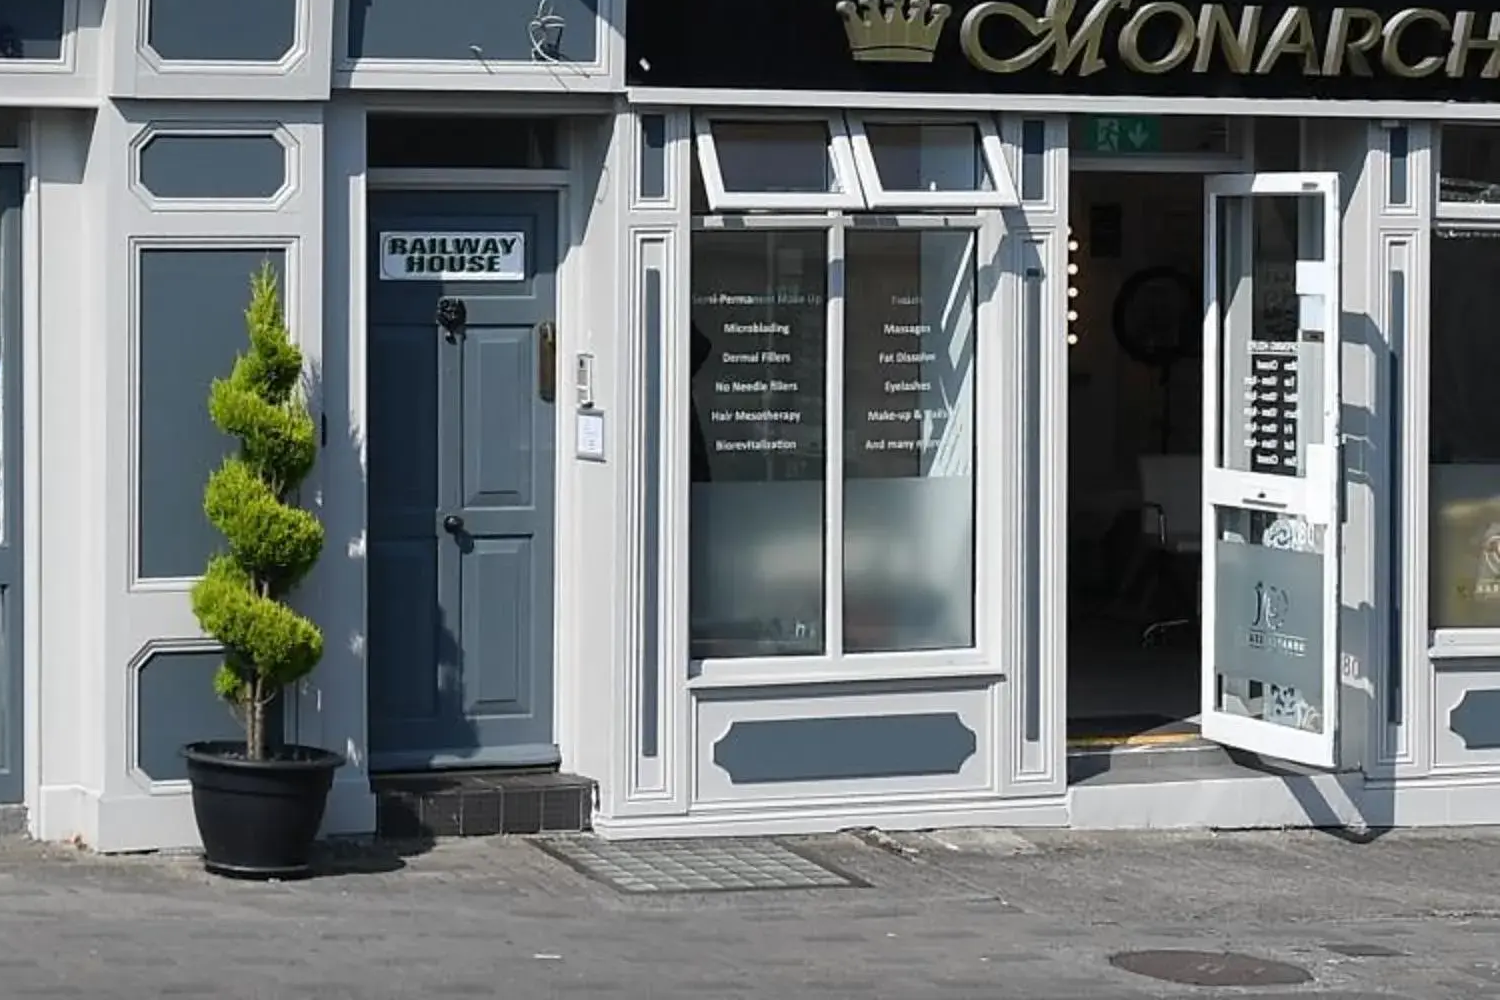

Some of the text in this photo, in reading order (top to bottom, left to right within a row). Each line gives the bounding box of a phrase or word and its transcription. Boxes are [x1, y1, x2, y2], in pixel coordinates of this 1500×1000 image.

[387, 237, 516, 255] RAILWAY
[405, 255, 501, 273] HOUSE
[724, 322, 790, 335] Microblading
